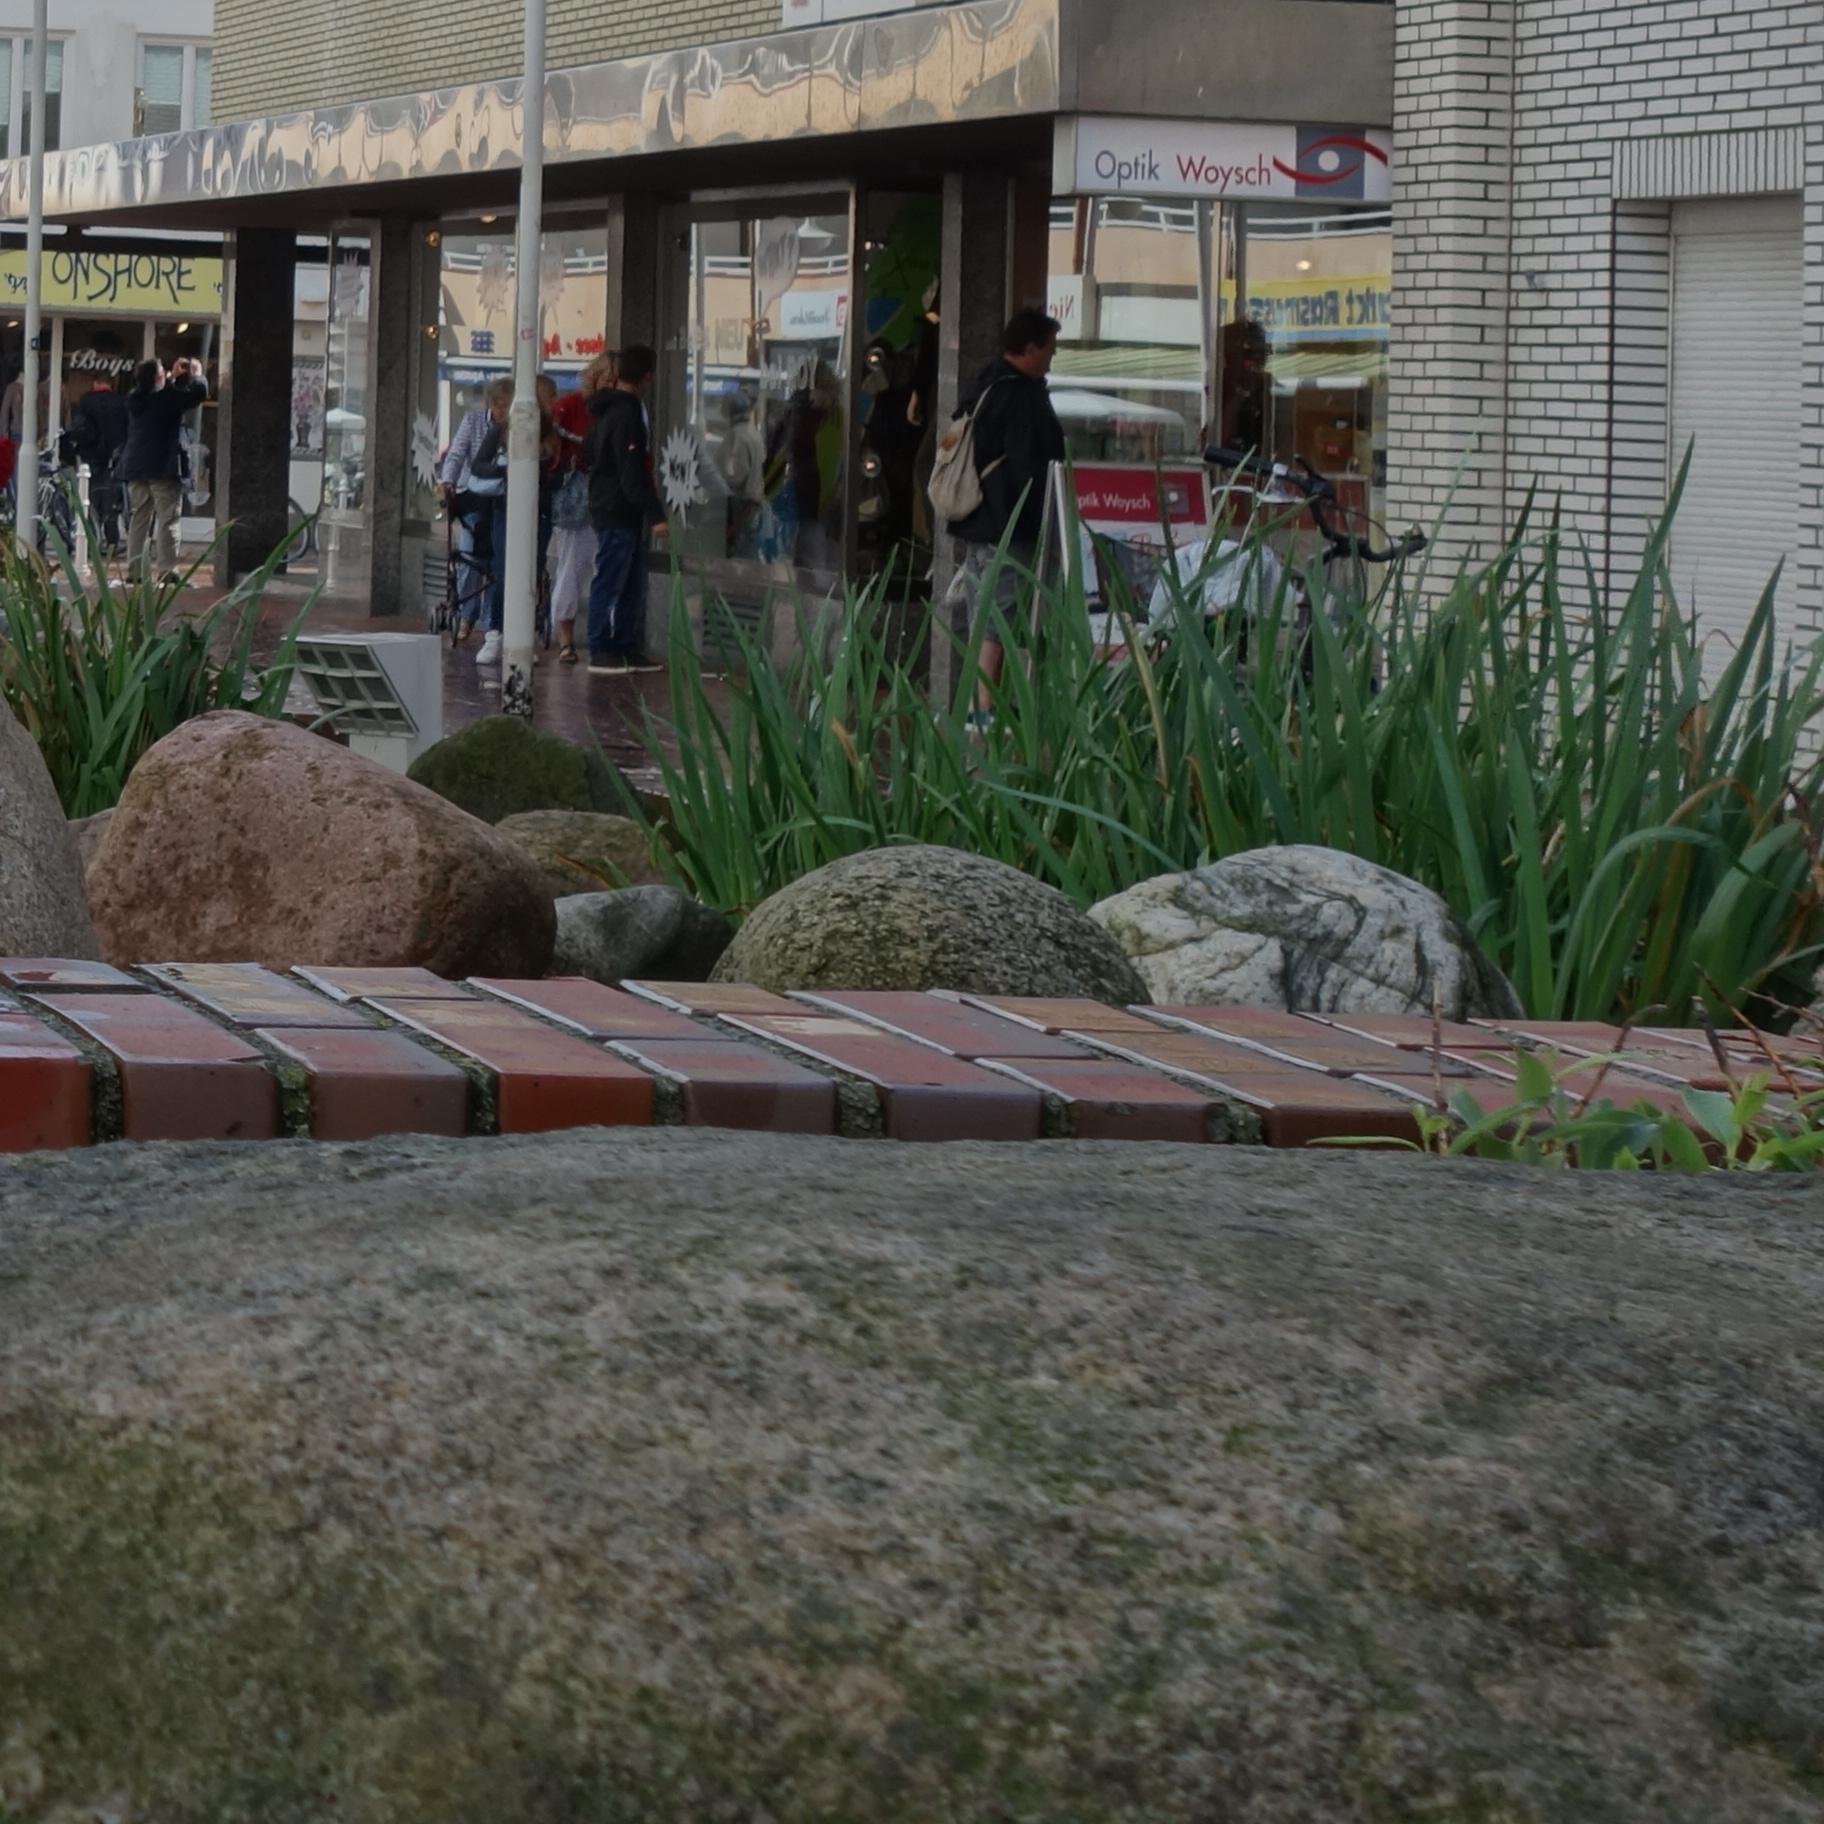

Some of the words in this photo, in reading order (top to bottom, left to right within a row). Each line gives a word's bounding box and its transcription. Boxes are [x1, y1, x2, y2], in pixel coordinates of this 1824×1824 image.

[1095, 149, 1160, 188] Optik
[1176, 153, 1272, 193] Woysch
[52, 251, 196, 305] ONSHORE
[69, 349, 135, 378] Boys
[1077, 491, 1100, 511] ptik
[1103, 492, 1152, 513] Woysch
